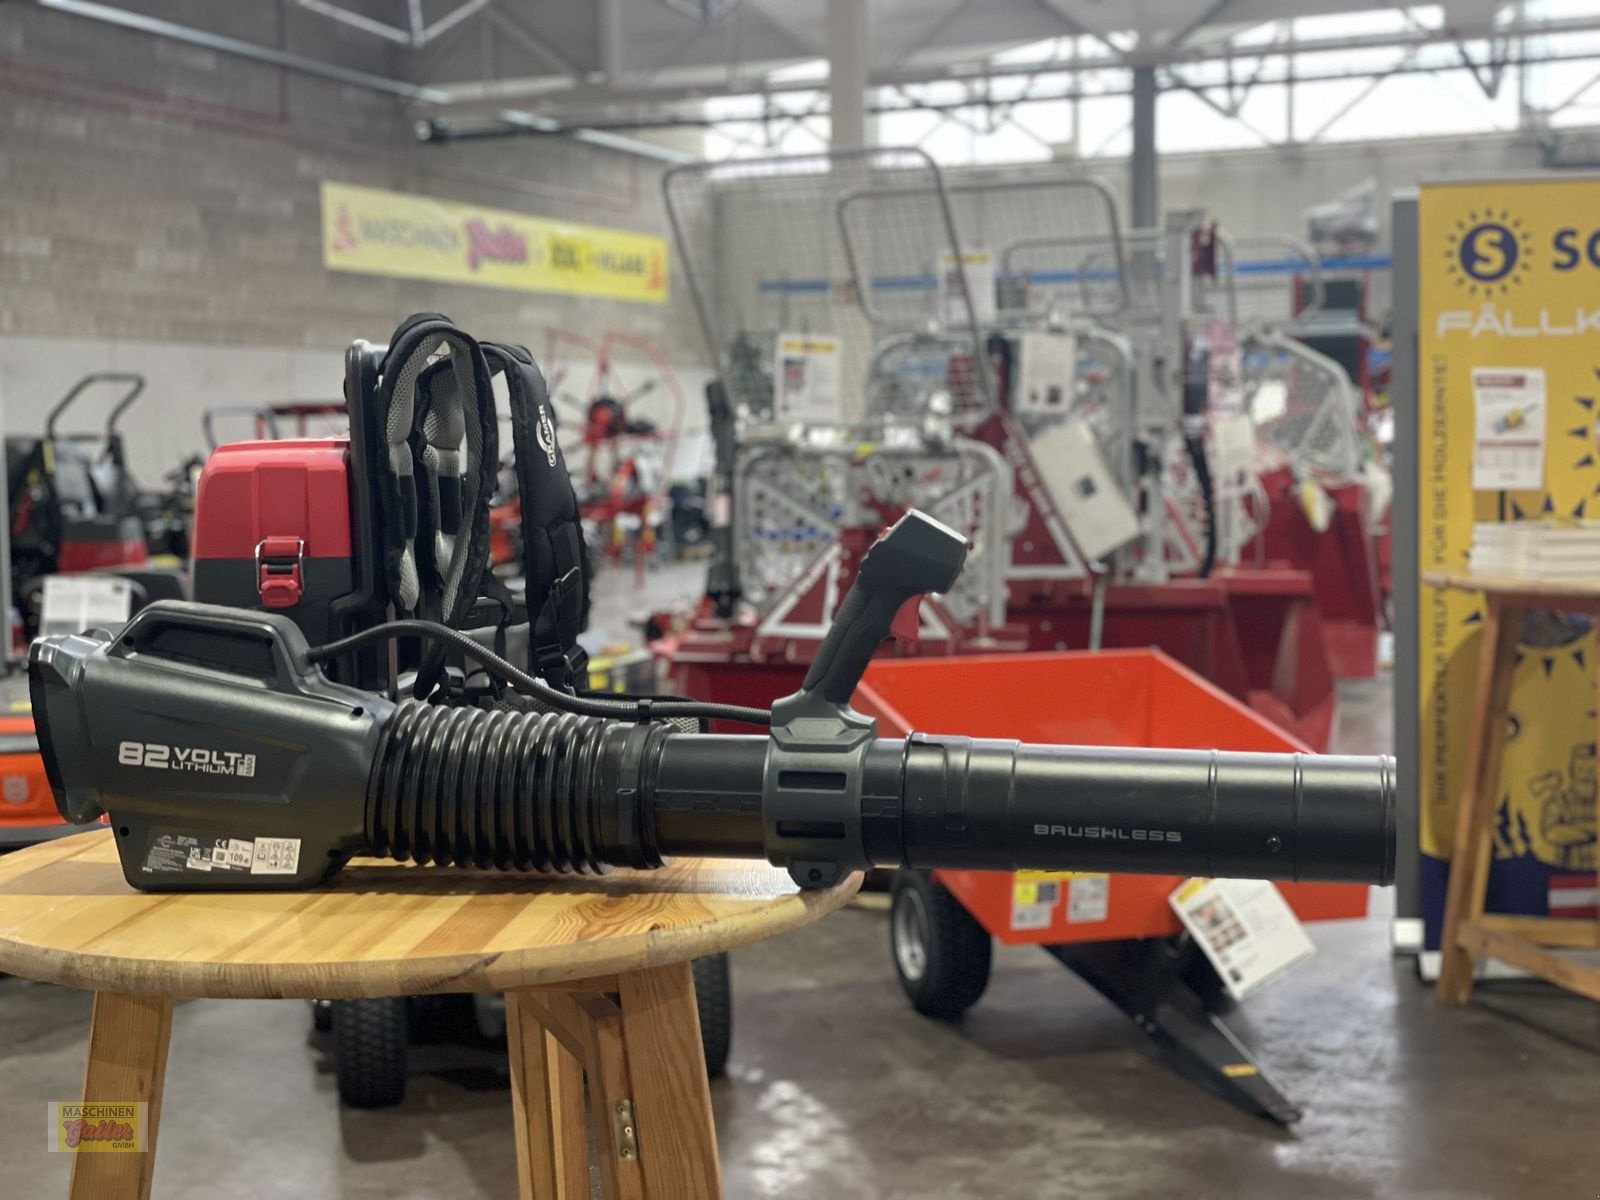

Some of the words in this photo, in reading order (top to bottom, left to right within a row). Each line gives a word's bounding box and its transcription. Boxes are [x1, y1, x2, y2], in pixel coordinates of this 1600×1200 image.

[538, 404, 557, 467] CRAMER
[118, 741, 170, 769] 82
[173, 747, 243, 767] VOLT
[171, 760, 235, 775] LITHIUM
[1033, 823, 1182, 843] BRUSHLESS
[230, 852, 244, 862] 109
